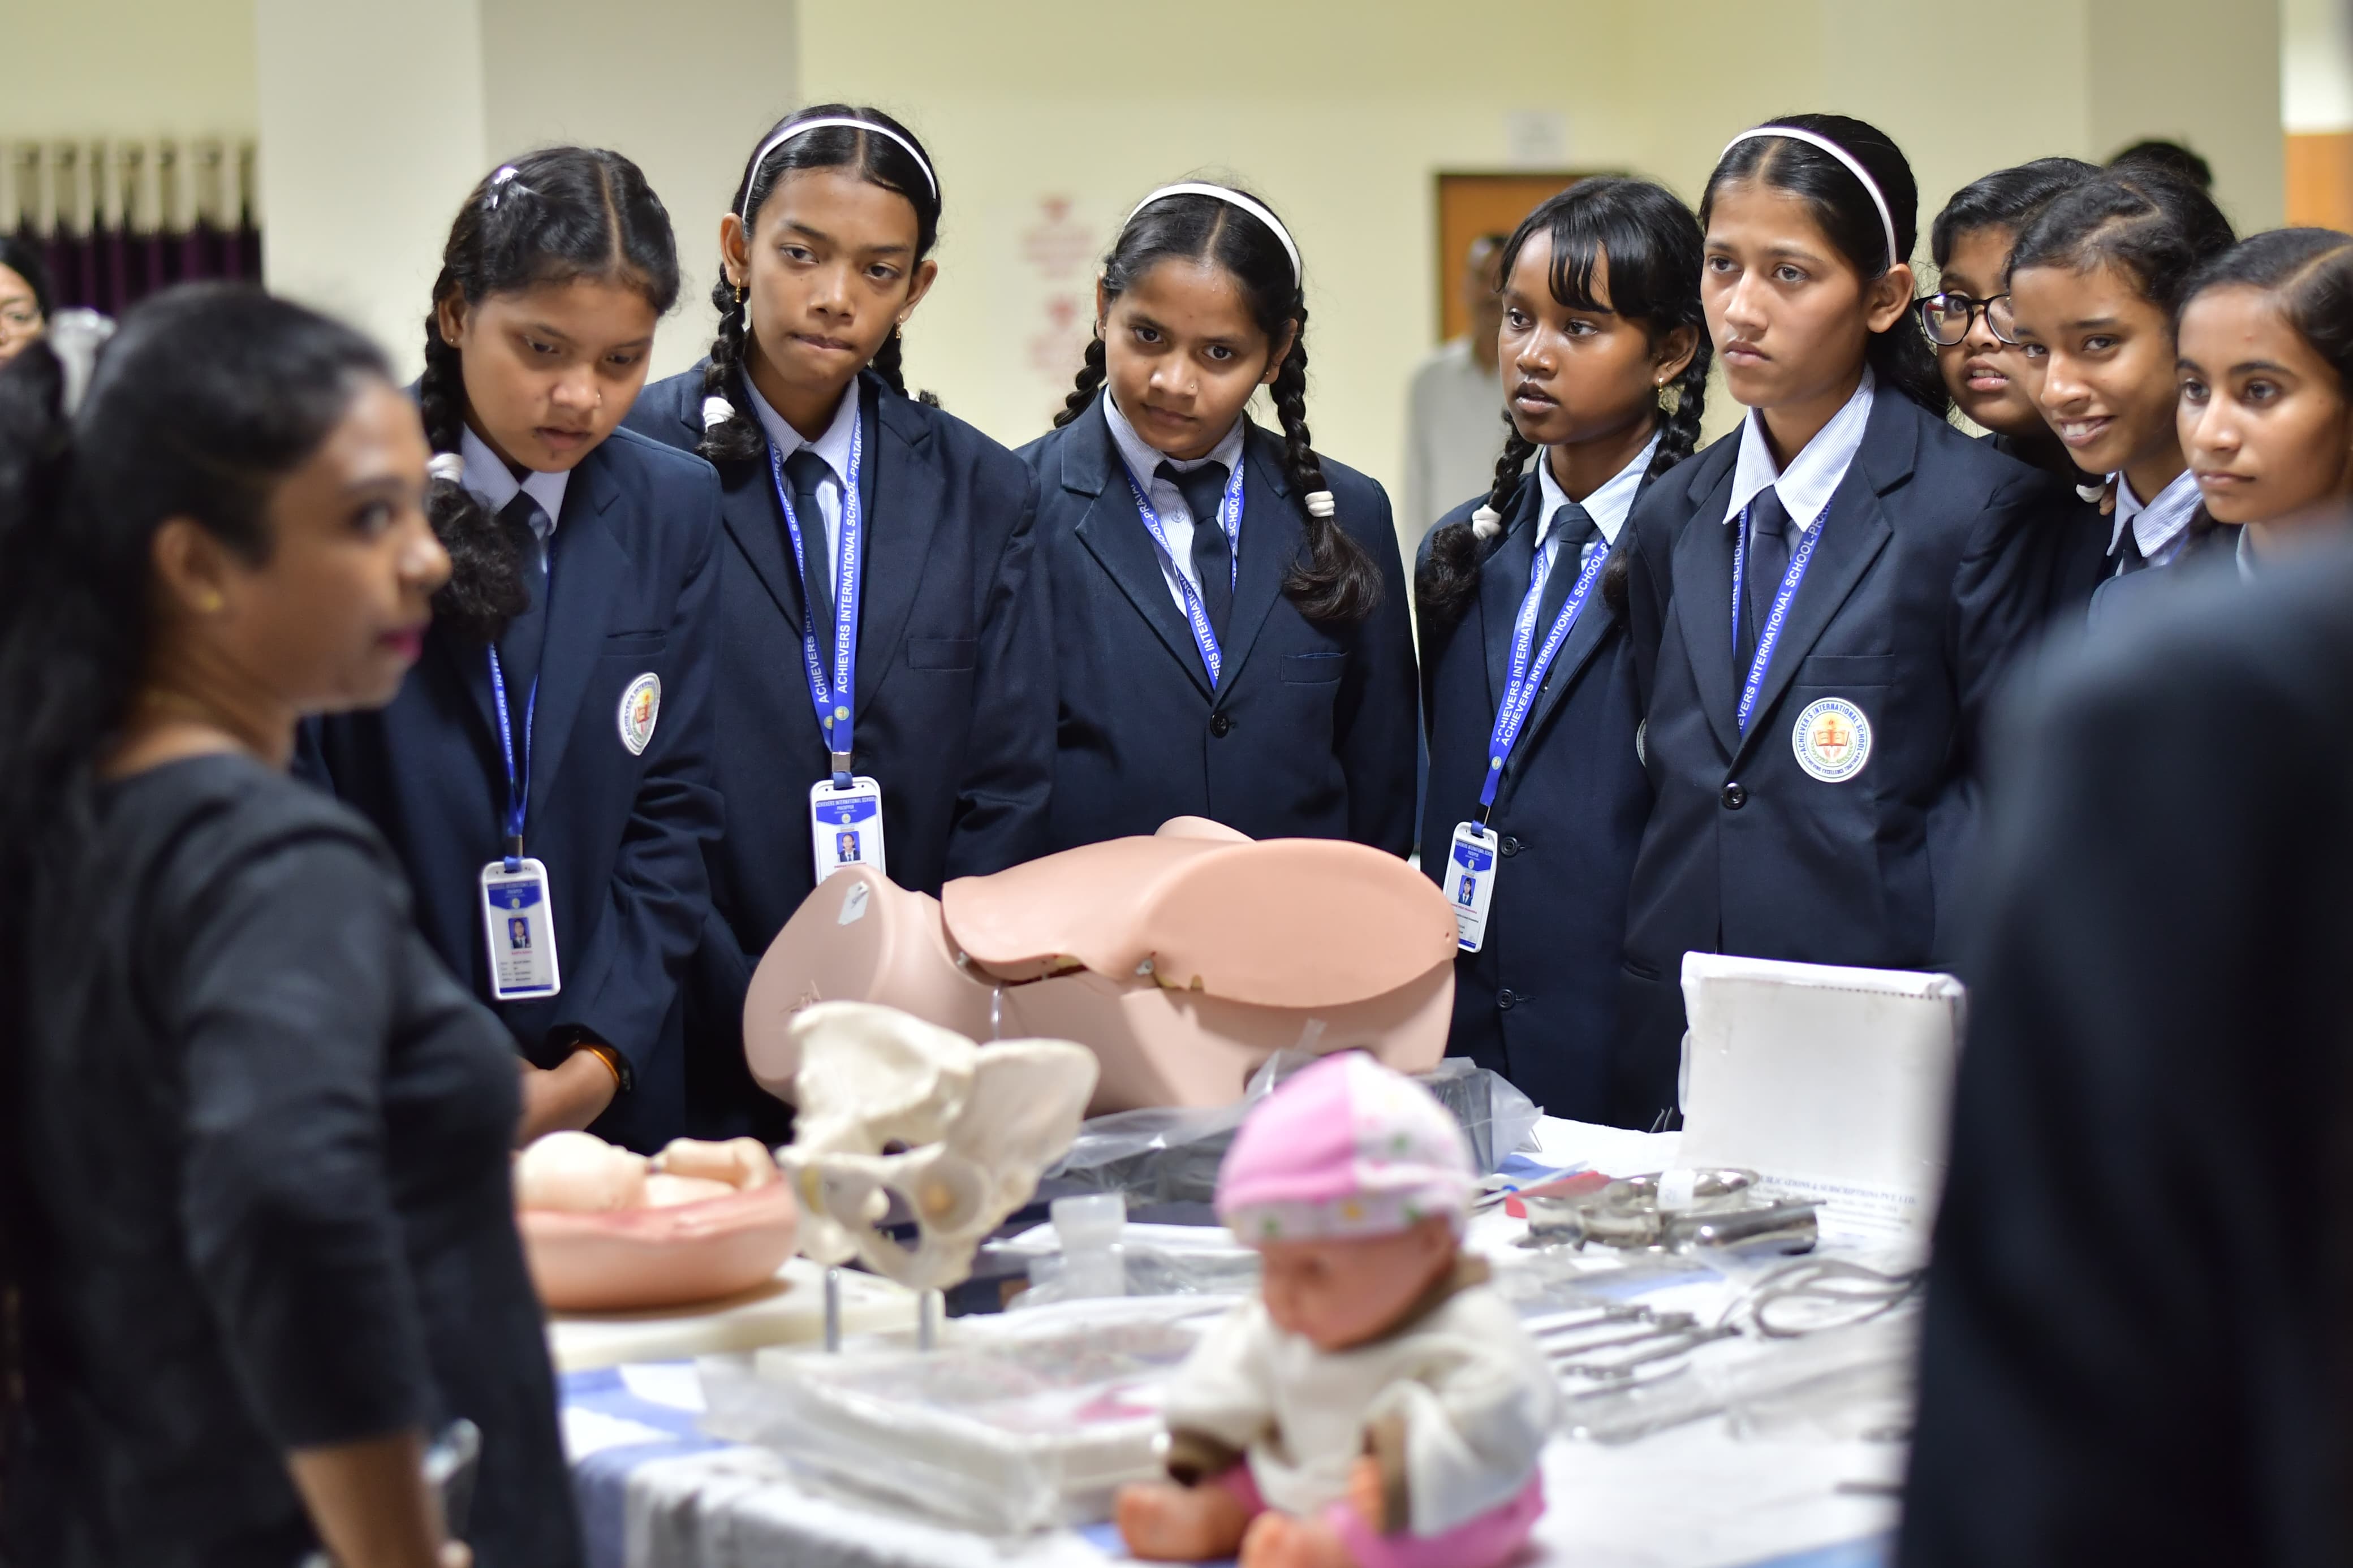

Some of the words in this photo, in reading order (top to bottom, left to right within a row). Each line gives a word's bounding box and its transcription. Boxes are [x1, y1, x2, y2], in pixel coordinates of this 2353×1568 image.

[840, 529, 855, 621] INTERNATIONAL
[807, 636, 830, 703] ACHIEVERS
[837, 625, 851, 694] ACHIEVERS
[1501, 683, 1534, 746] ACHIEVERS
[1529, 599, 1580, 682] INTERNATIONAL
[1512, 593, 1539, 677] INTERNATIONAL
[1750, 590, 1792, 684] INTERNATIONAL
[1798, 712, 1813, 752] ACHIEVER'S
[1812, 703, 1859, 724] INTERNATIONAL
[1856, 724, 1865, 751] SCHOOL
